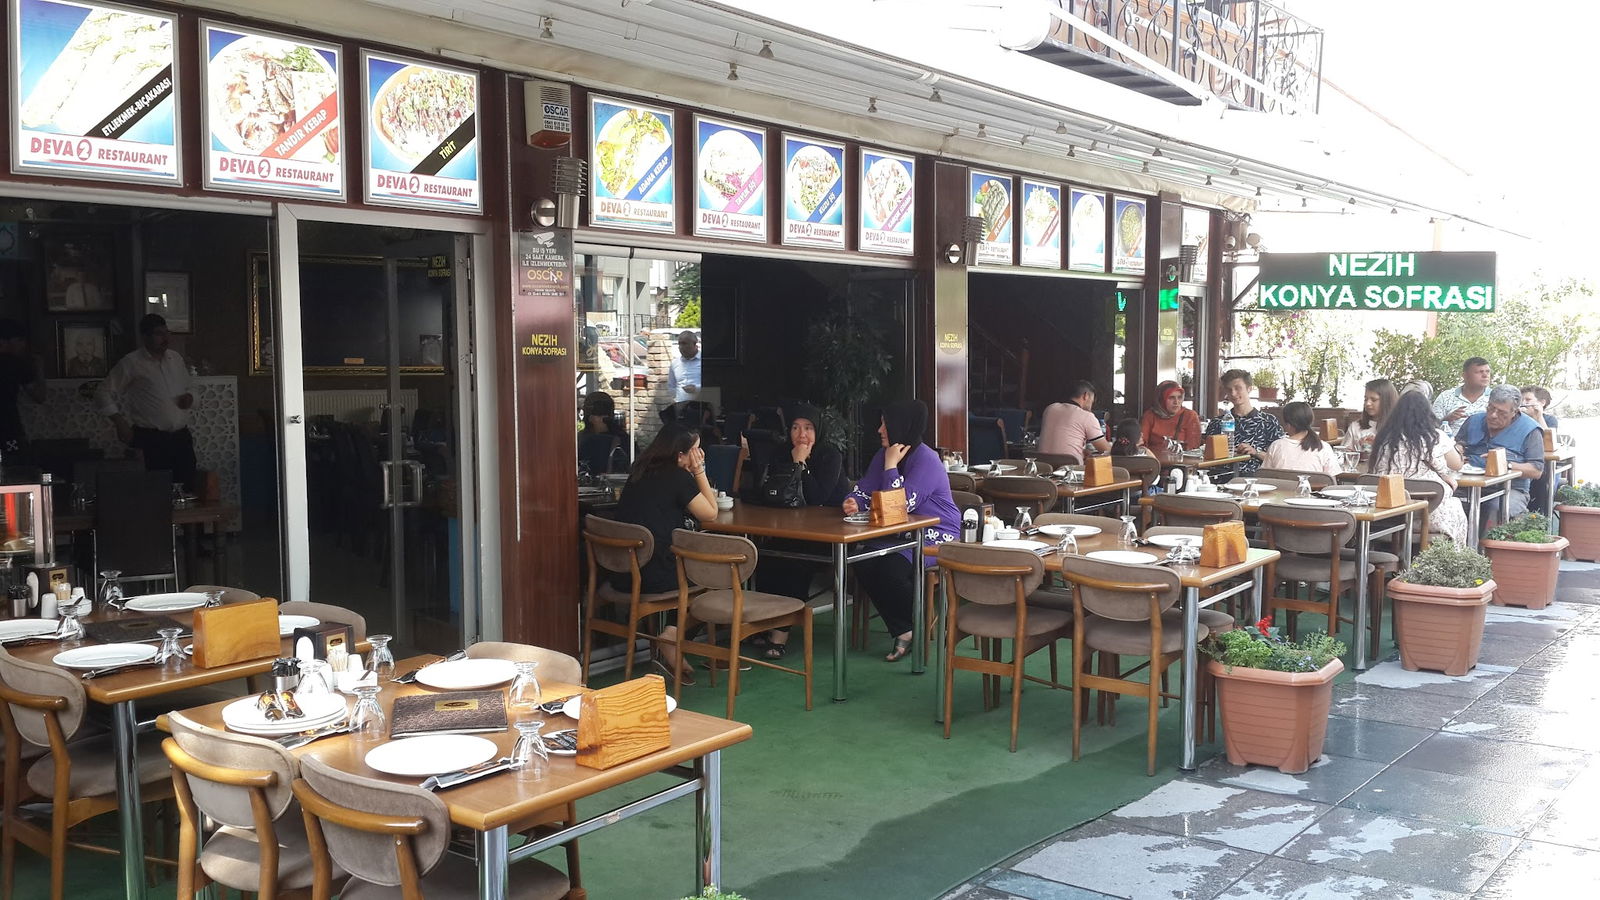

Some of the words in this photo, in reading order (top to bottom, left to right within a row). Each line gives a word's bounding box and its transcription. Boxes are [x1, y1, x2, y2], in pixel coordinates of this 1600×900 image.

[544, 104, 568, 116] OSCAR
[274, 128, 306, 156] TANDIR
[302, 109, 328, 134] KEBAP
[30, 136, 74, 157] DEVA
[98, 148, 168, 166] RESTAURANT
[438, 140, 457, 160] TİRİT
[219, 157, 256, 175] DEVA
[275, 167, 334, 182] RESTAURANT
[377, 174, 408, 190] DEVA
[423, 183, 473, 197] RESTAURANT
[600, 201, 622, 214] DEVA
[633, 208, 668, 219] RESTAURANT
[702, 212, 721, 225] DEVA
[730, 219, 761, 230] RESTAURANT
[789, 223, 806, 234] DEVA
[813, 228, 840, 238] RESTAURANT
[865, 231, 880, 241] DEVA
[1329, 252, 1415, 277] NEZİH
[527, 267, 563, 283] OSCAR
[1260, 284, 1357, 308] KONYA
[1363, 285, 1493, 310] SOFRASI
[522, 347, 542, 355] KONYA
[543, 347, 567, 356] SOFRASI
